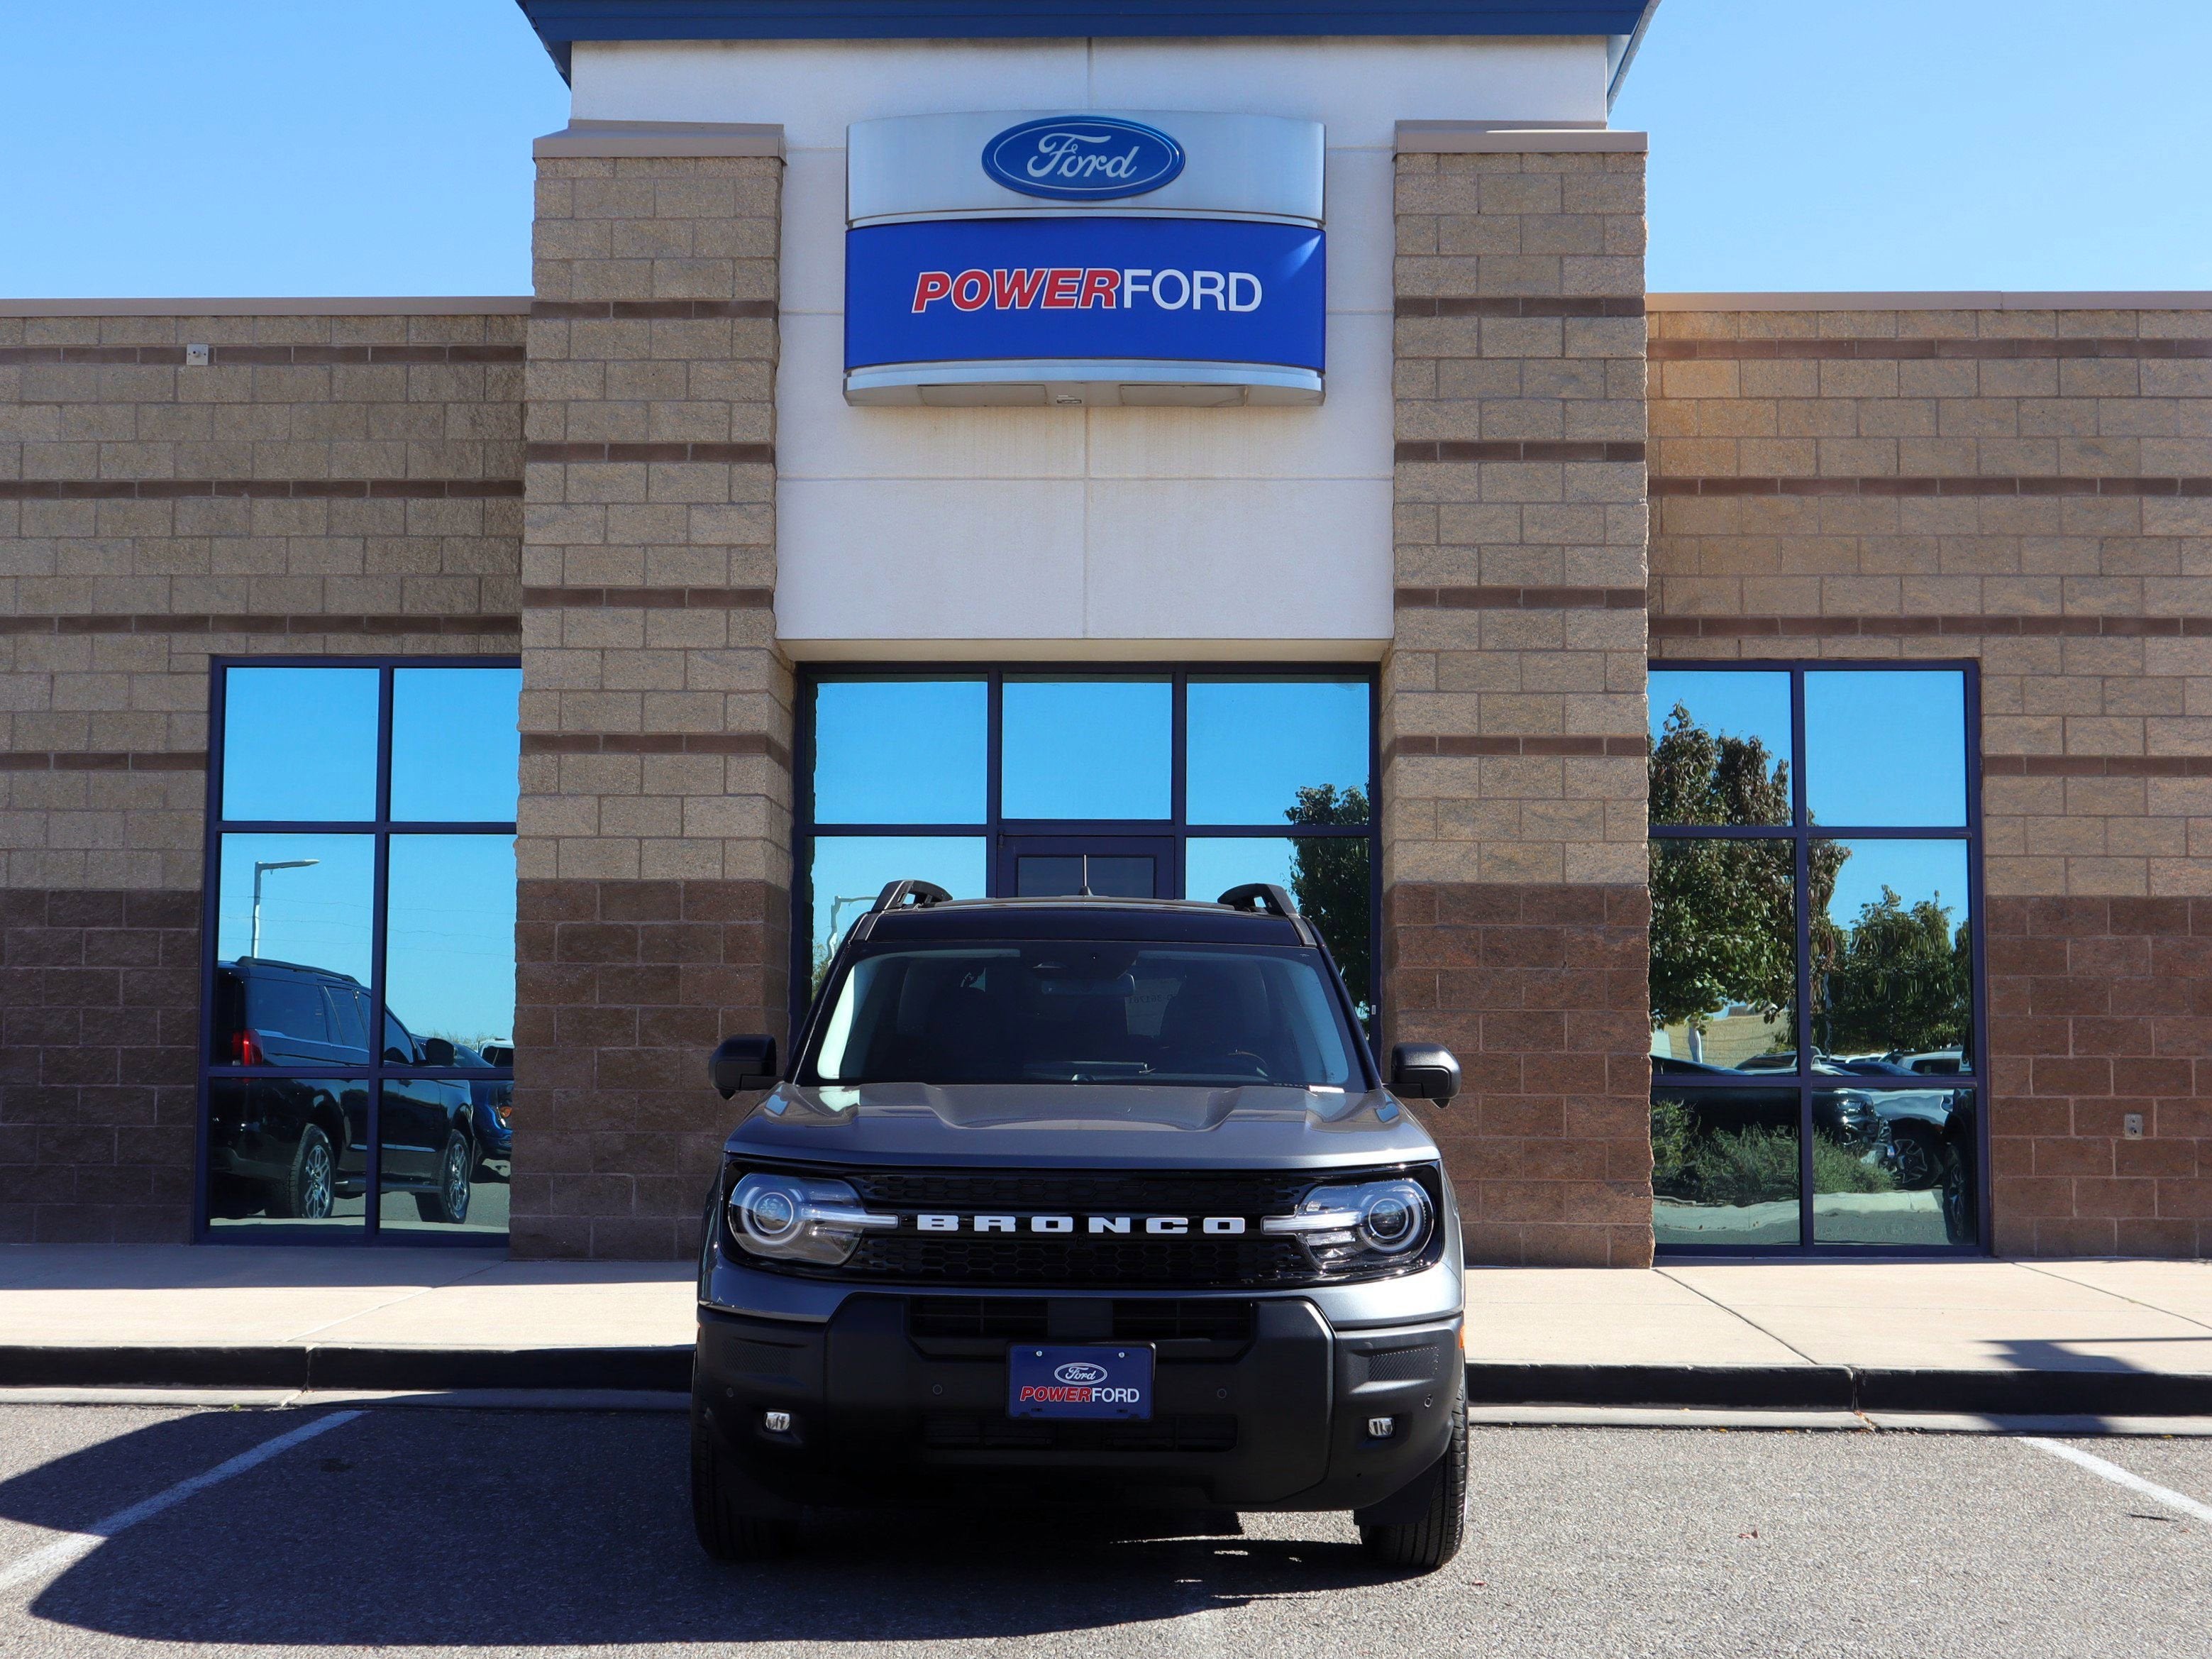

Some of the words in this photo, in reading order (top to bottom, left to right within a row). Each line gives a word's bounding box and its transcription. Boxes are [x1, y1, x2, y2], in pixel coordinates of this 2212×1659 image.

[1027, 132, 1140, 178] Ford
[917, 1214, 1246, 1234] BRONCO
[1065, 1367, 1097, 1381] Ford
